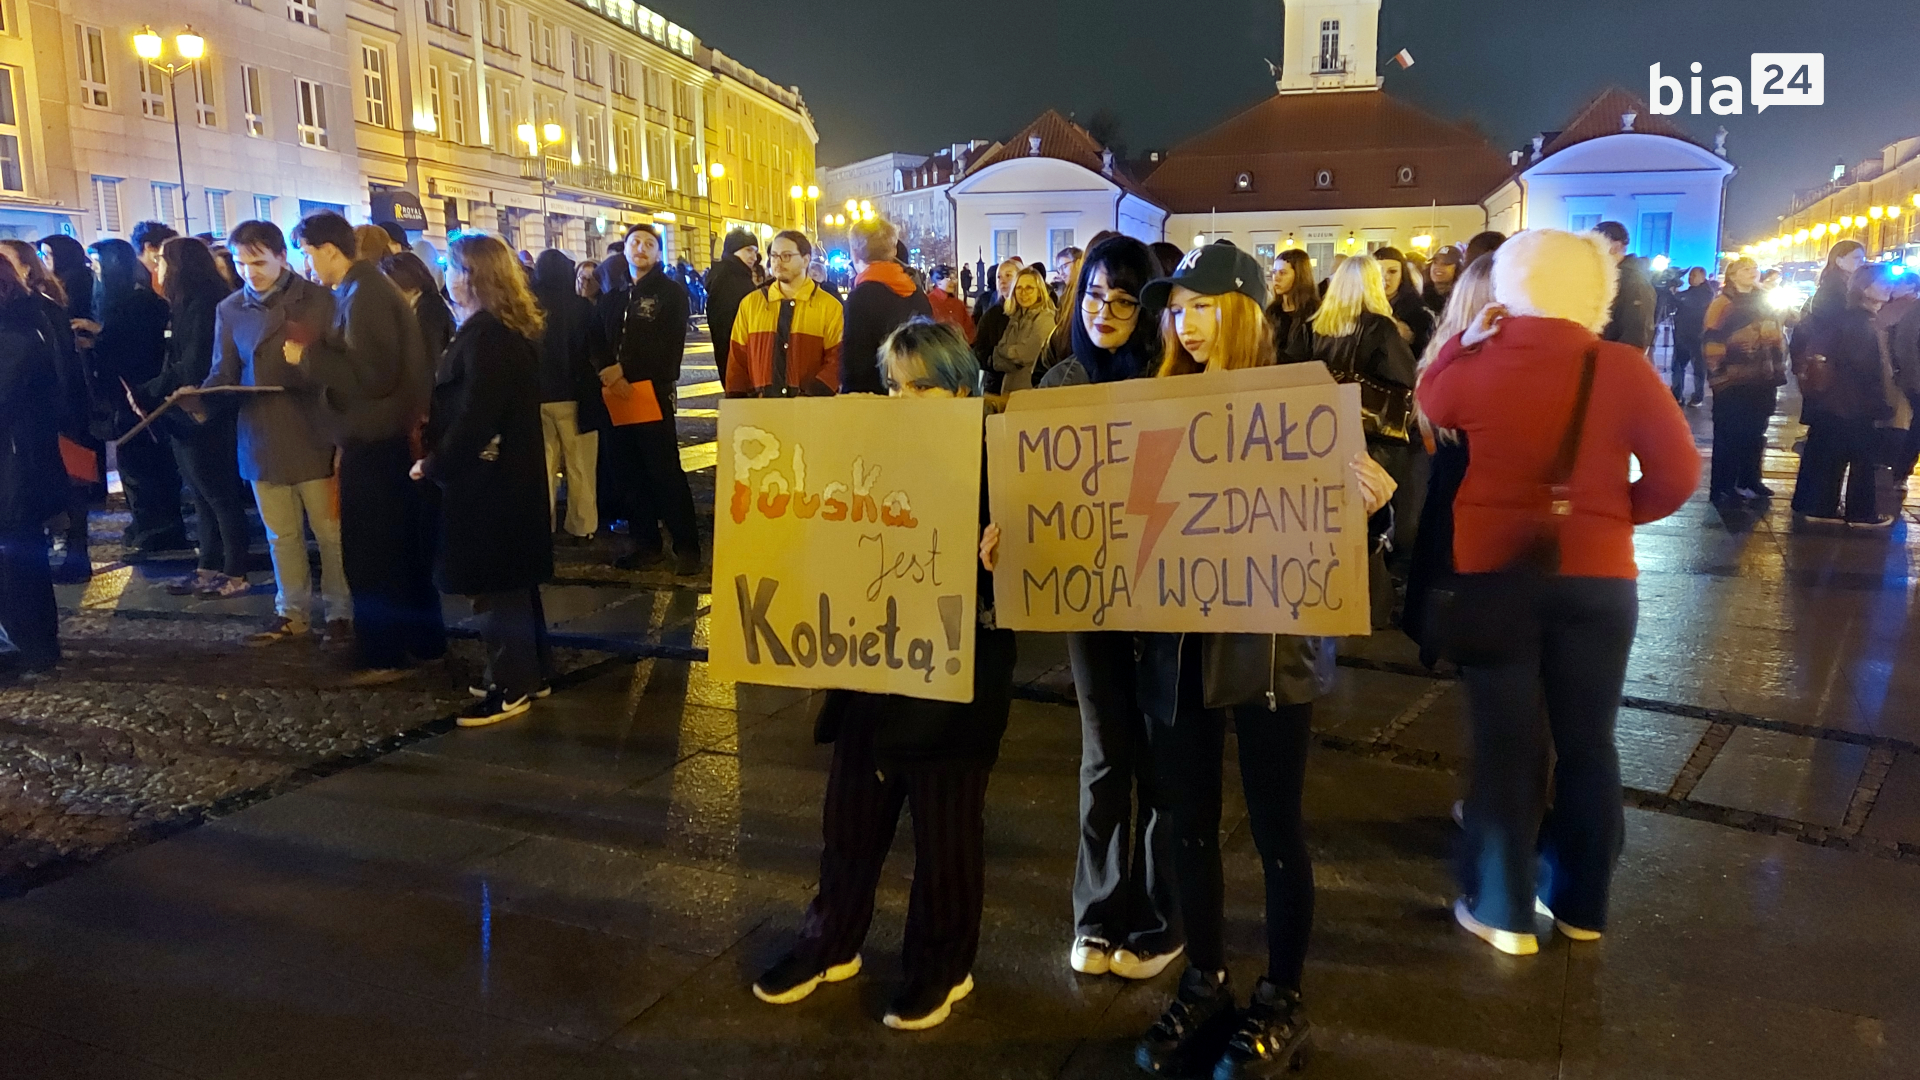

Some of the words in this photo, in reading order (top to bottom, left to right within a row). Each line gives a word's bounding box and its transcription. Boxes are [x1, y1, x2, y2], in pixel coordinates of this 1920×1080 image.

[402, 206, 423, 216] ROYAL
[730, 424, 918, 529] Polska
[1018, 421, 1133, 496] MOJE
[1027, 500, 1129, 569] MOJE
[1022, 565, 1132, 626] MOJA
[1158, 541, 1343, 620] WOLNOŚĆ
[734, 573, 963, 683] Kobietą!
